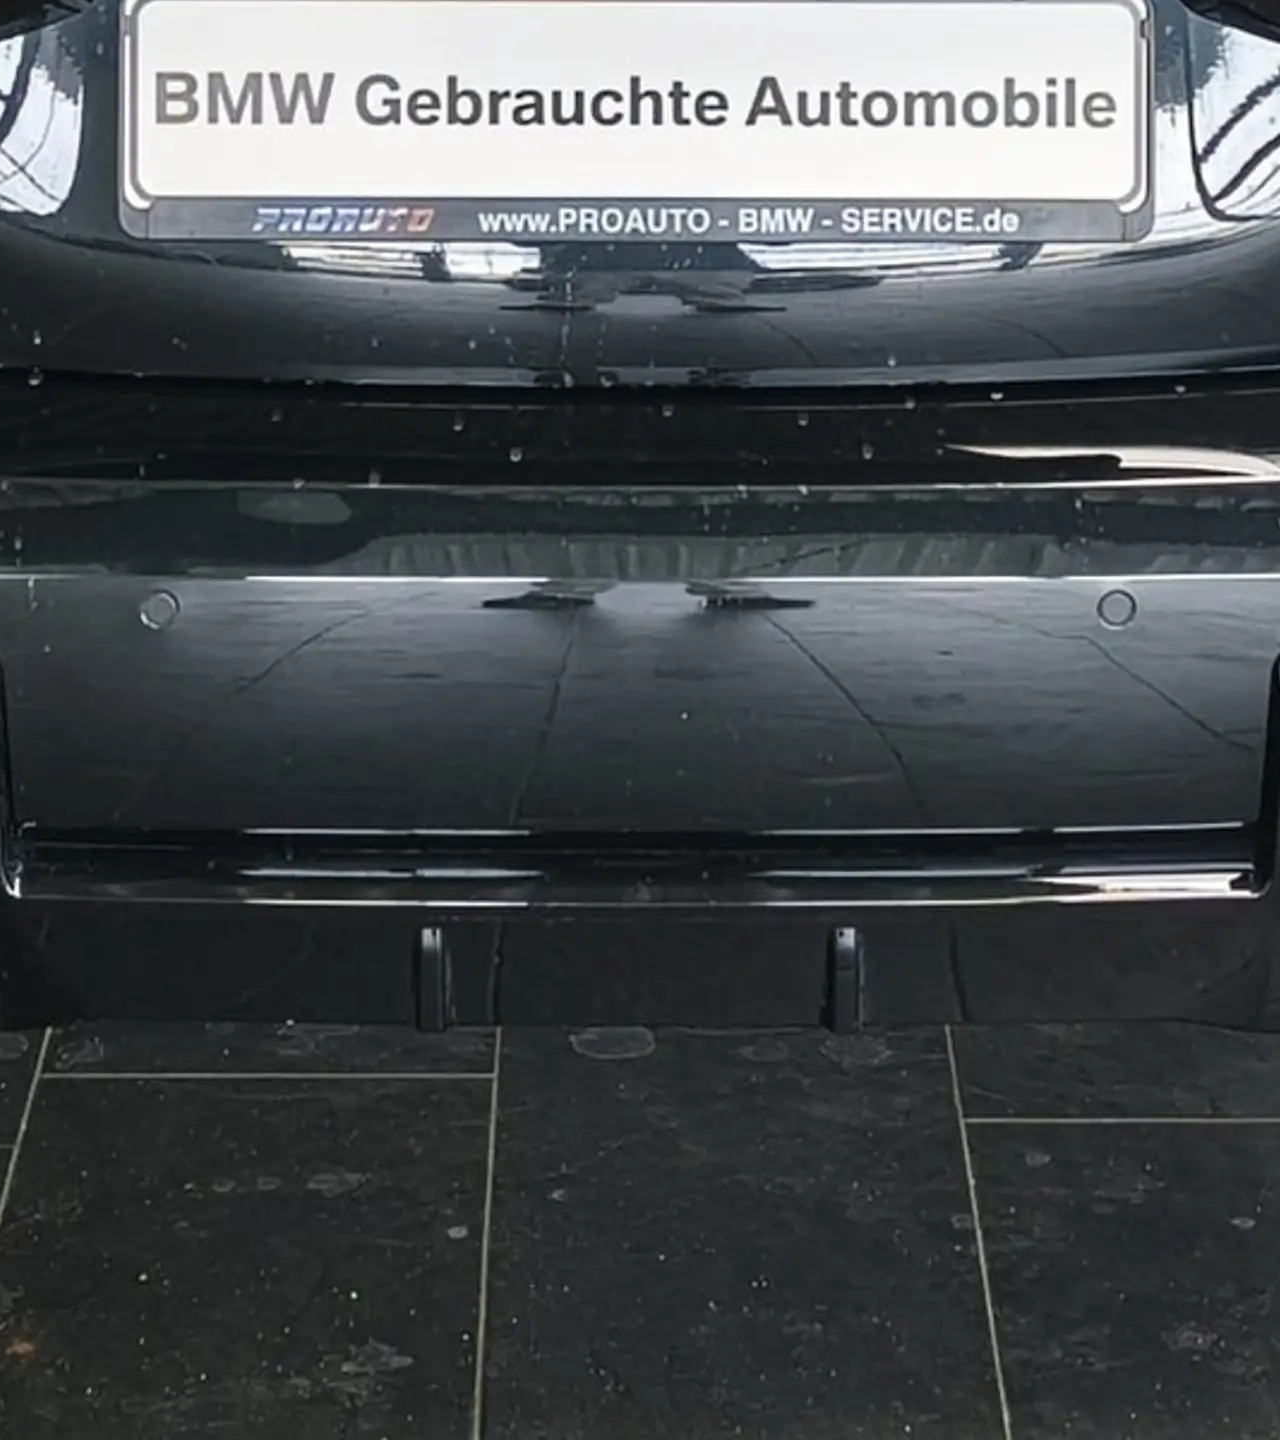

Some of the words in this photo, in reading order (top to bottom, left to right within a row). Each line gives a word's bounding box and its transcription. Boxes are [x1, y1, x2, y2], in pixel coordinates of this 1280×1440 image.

[154, 71, 335, 126] BMW
[355, 74, 729, 127] Gebrauchte
[744, 75, 1117, 128] Automobile
[477, 207, 711, 234] www.PROAUTO
[737, 207, 815, 234] BMW
[840, 207, 1020, 234] SERVICE.de
